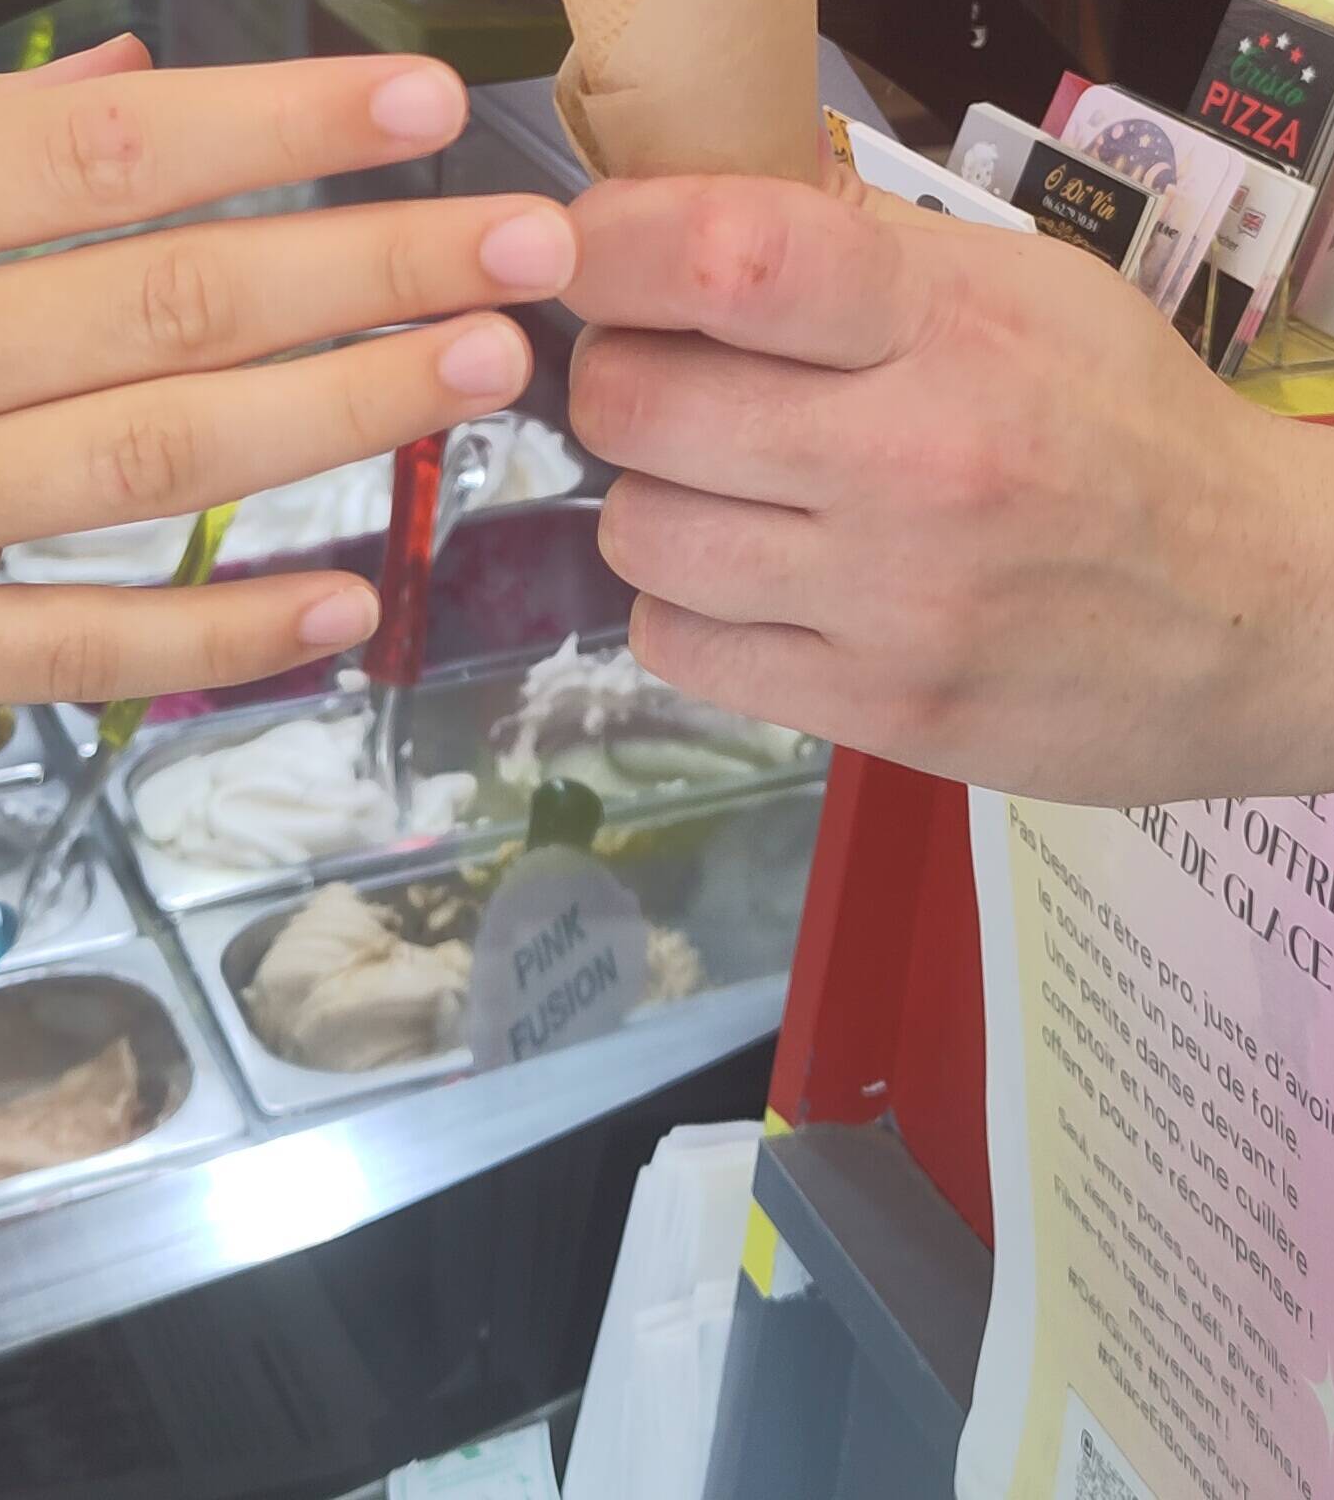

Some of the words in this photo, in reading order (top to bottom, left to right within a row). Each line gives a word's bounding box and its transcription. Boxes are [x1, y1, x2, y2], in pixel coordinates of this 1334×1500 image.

[1200, 80, 1301, 159] PIZZA
[513, 902, 587, 992] PINK
[1009, 802, 1038, 852] Pas
[1039, 832, 1094, 913] besoin
[1097, 901, 1153, 970] d'être
[1157, 958, 1197, 1014] pro,
[1202, 990, 1258, 1060] juste
[1180, 829, 1218, 898] DE
[1223, 873, 1334, 992] GLACE
[508, 947, 619, 1063] FUSION
[1038, 877, 1053, 914] le
[1055, 904, 1113, 979] sourire
[1117, 970, 1138, 1004] et
[1141, 993, 1166, 1032] un
[1171, 1021, 1211, 1074] peu
[1217, 1063, 1246, 1104] de
[1251, 1087, 1302, 1161] folie.
[1044, 930, 1077, 987] Une
[1080, 977, 1131, 1045] petite
[1136, 1036, 1195, 1109] danse
[1201, 1099, 1278, 1187] devant
[1281, 1166, 1299, 1211] le
[1041, 1025, 1096, 1100] offerte
[1099, 1091, 1139, 1147] pour
[1143, 1138, 1165, 1176] te
[1168, 1167, 1303, 1324] récompenser
[1120, 1068, 1140, 1103] et
[1142, 1085, 1185, 1153] hop,
[1190, 1138, 1231, 1192] une
[1235, 1184, 1309, 1277] cuillère
[1092, 1153, 1134, 1206] entre
[1137, 1200, 1184, 1261] potes
[1186, 1255, 1209, 1290] ou
[1211, 1282, 1234, 1317] en
[1237, 1303, 1290, 1386] famille
[1121, 1219, 1170, 1286] tenter
[1173, 1271, 1189, 1307] le
[1191, 1299, 1224, 1349] défi
[1227, 1340, 1267, 1400] givré
[1128, 1306, 1223, 1429] mouvement
[1220, 1374, 1238, 1407] et
[1240, 1399, 1293, 1480] rejoins
